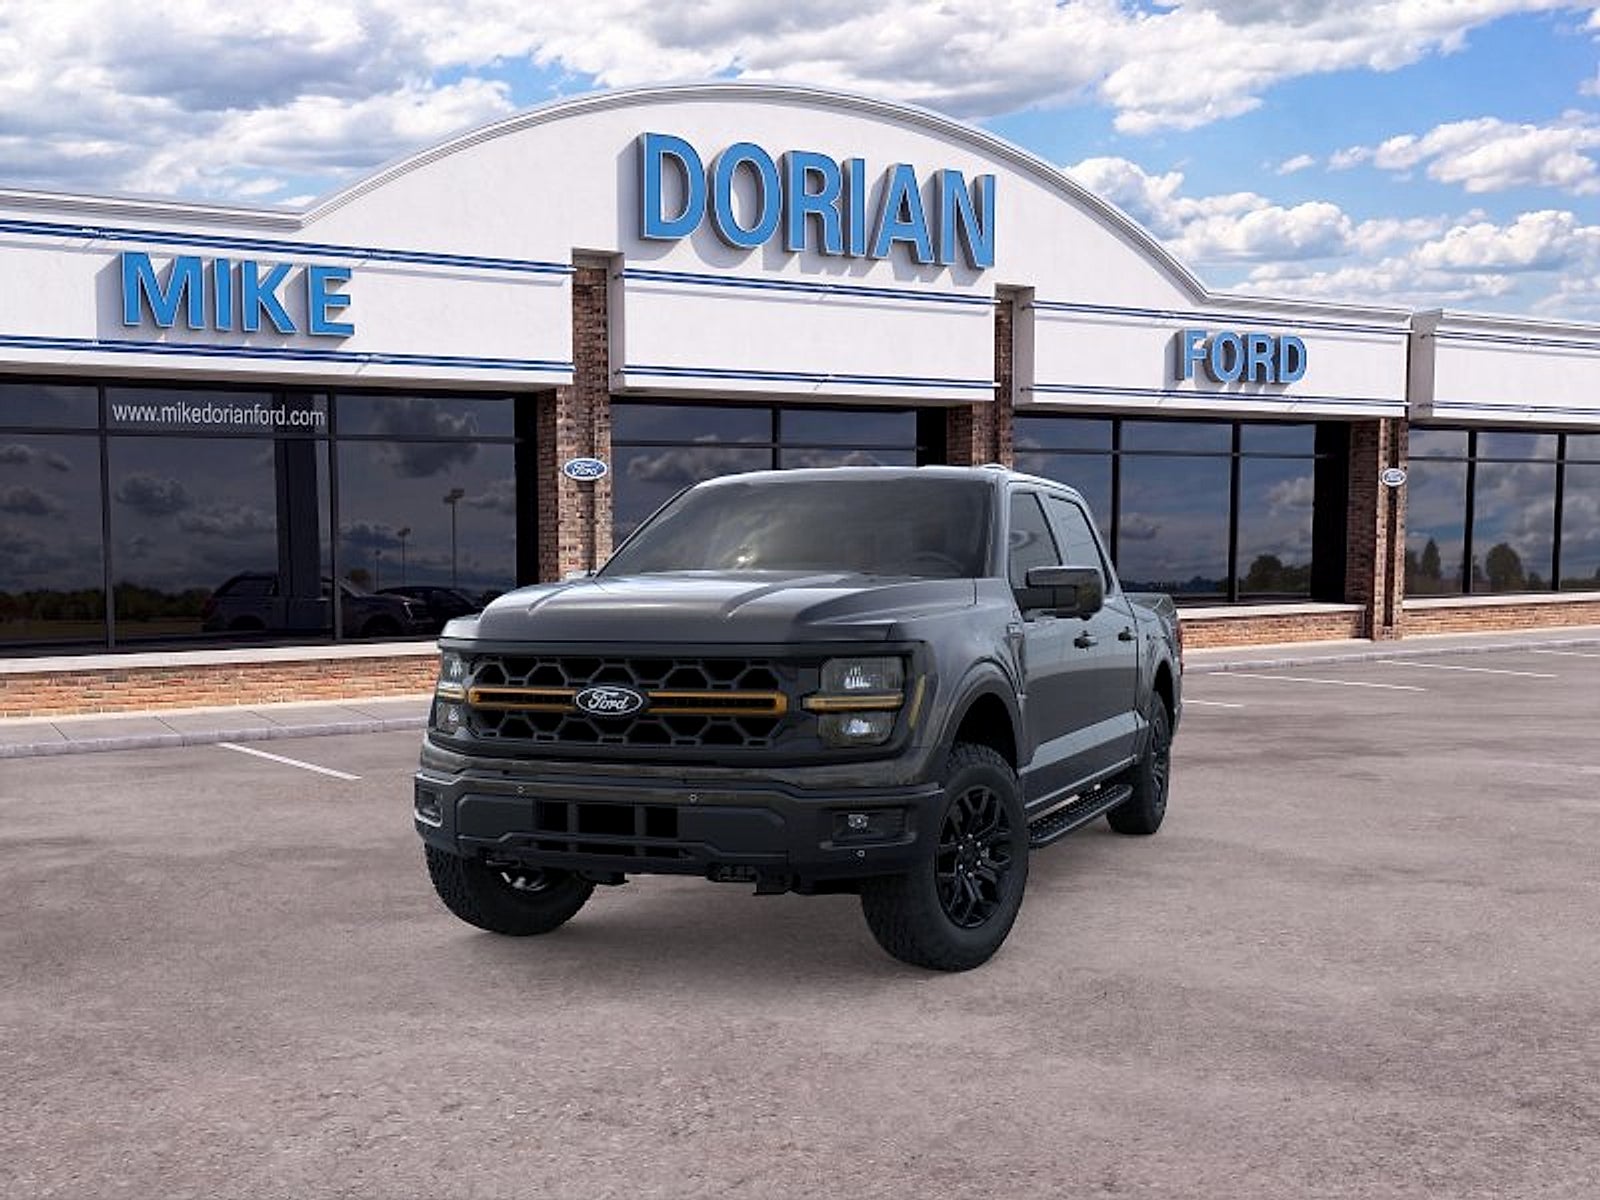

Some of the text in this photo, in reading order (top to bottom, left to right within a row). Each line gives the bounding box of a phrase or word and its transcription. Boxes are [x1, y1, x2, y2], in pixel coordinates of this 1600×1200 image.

[639, 132, 995, 269] DORIAN
[121, 251, 355, 337] MIKE
[1180, 328, 1308, 383] FORD
[111, 402, 326, 427] www.mikedorianford.com
[588, 691, 630, 710] Ford
